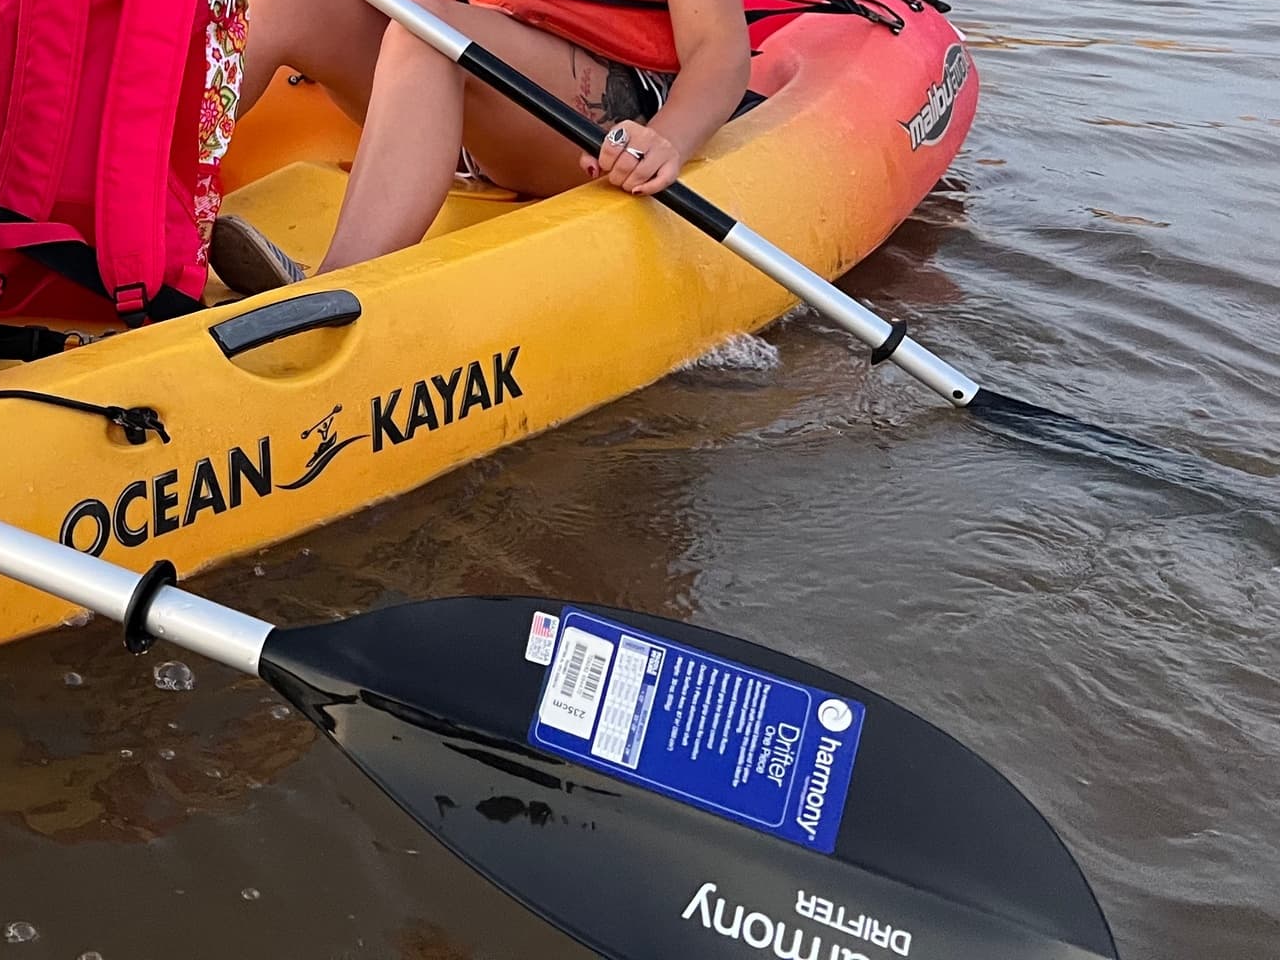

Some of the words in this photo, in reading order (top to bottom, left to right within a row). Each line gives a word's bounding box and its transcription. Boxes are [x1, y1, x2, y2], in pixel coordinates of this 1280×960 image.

[59, 436, 273, 558] OCEAN
[370, 346, 523, 453] KAYAK
[553, 699, 586, 719] 235cm
[760, 725, 775, 748] One
[755, 748, 771, 774] Piece
[766, 721, 801, 788] Drifter
[796, 736, 842, 836] harmony
[681, 883, 869, 960] mony
[795, 890, 912, 957] DRIFTER
